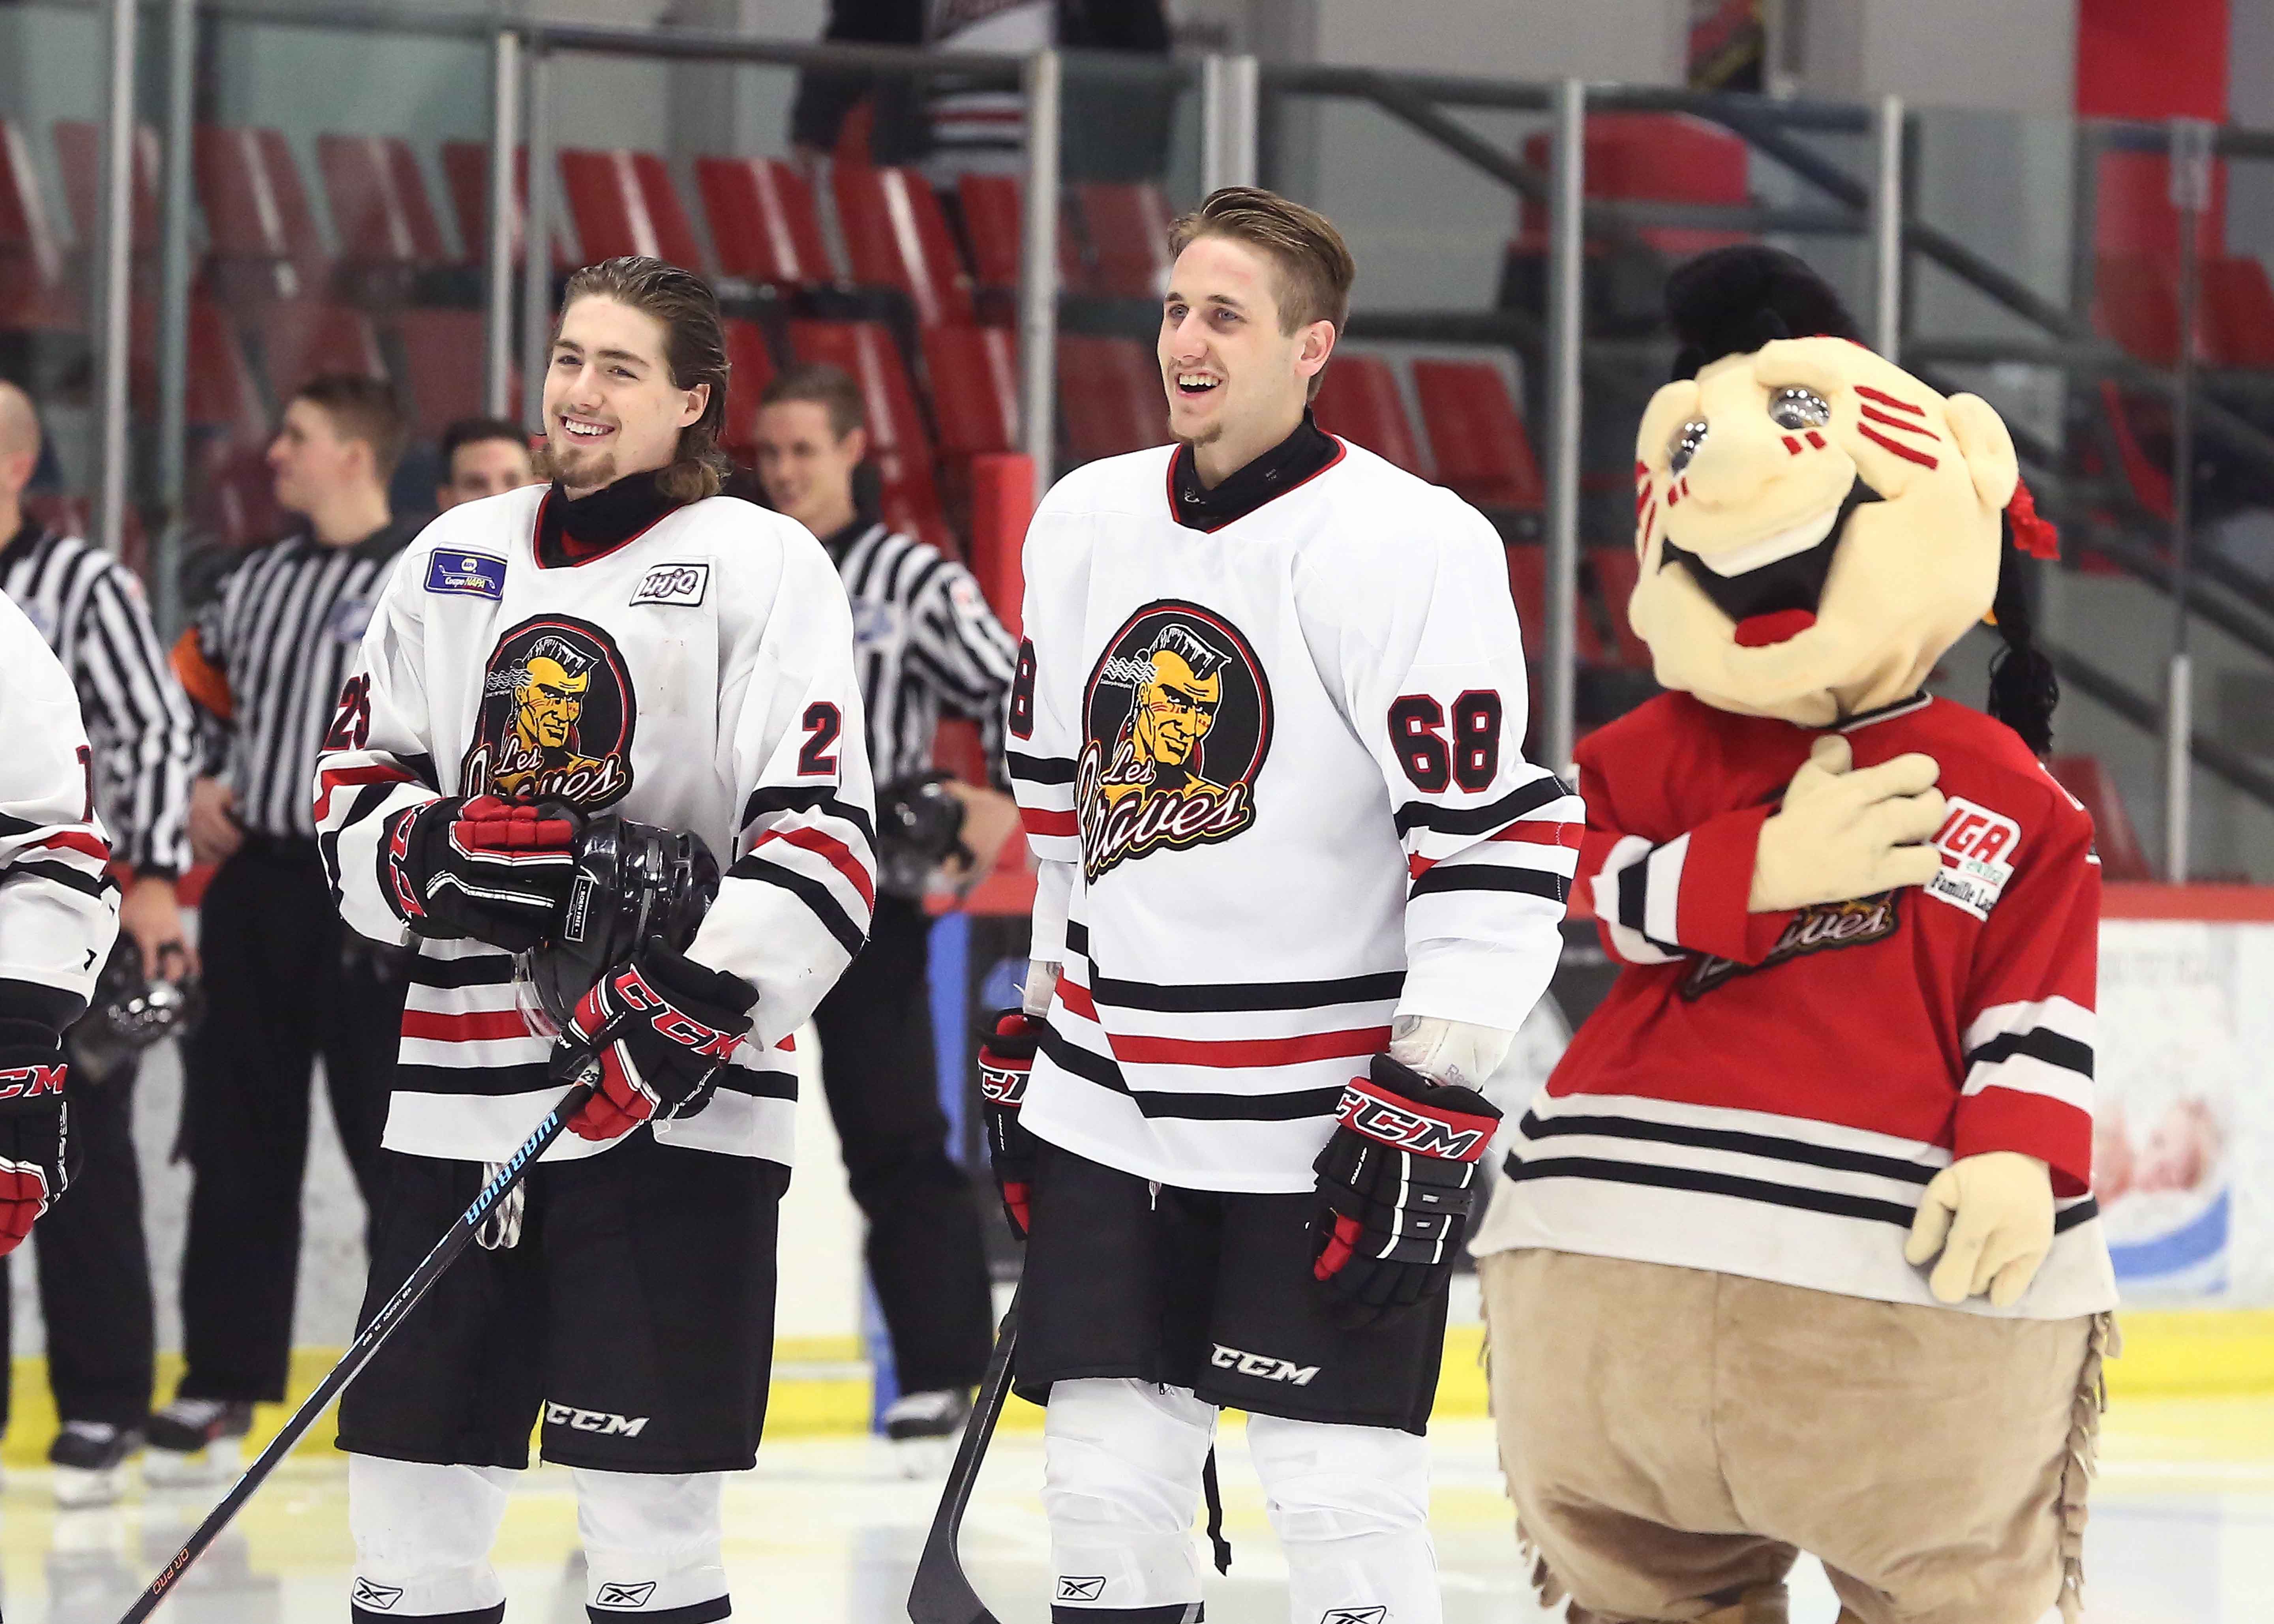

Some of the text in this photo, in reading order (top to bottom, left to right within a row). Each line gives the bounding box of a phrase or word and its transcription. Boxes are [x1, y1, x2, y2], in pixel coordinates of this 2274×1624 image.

[465, 576, 485, 589] NAPA
[494, 737, 542, 775] Les
[1387, 689, 1503, 794] 68
[1102, 743, 1154, 784] Les
[1930, 808, 2010, 864] IGA
[578, 891, 586, 911] BORN
[614, 962, 749, 1060] CCM
[464, 1110, 559, 1226] WARRIOR
[1211, 1342, 1322, 1387] CCM
[546, 1401, 651, 1438] CCM
[152, 1566, 174, 1595] PRO
